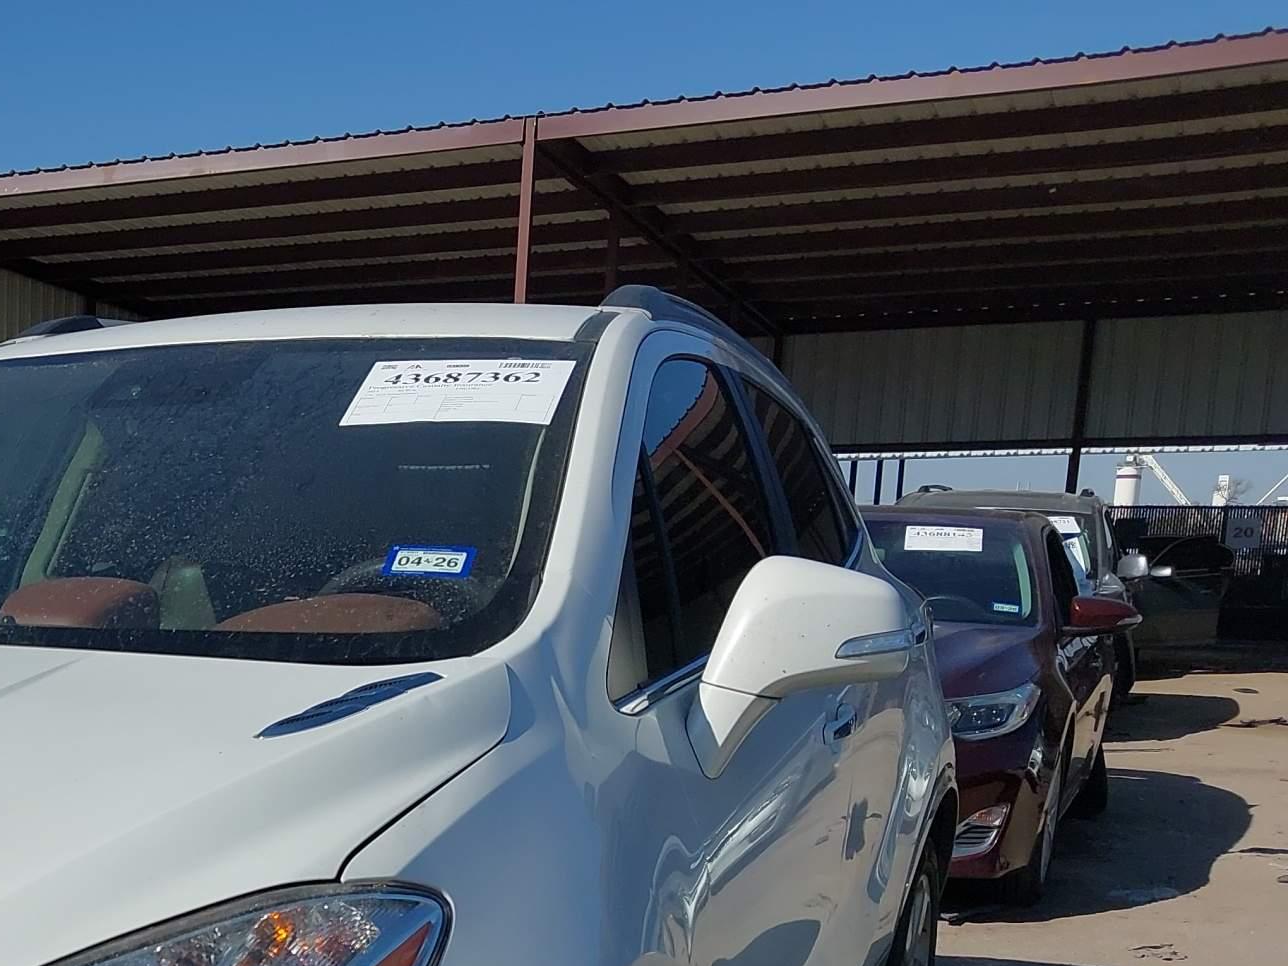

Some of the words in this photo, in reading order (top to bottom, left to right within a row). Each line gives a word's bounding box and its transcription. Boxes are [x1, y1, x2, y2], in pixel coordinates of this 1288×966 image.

[383, 372, 541, 385] 43687362
[1233, 527, 1255, 538] 20
[397, 556, 423, 567] 04
[432, 556, 460, 568] 26
